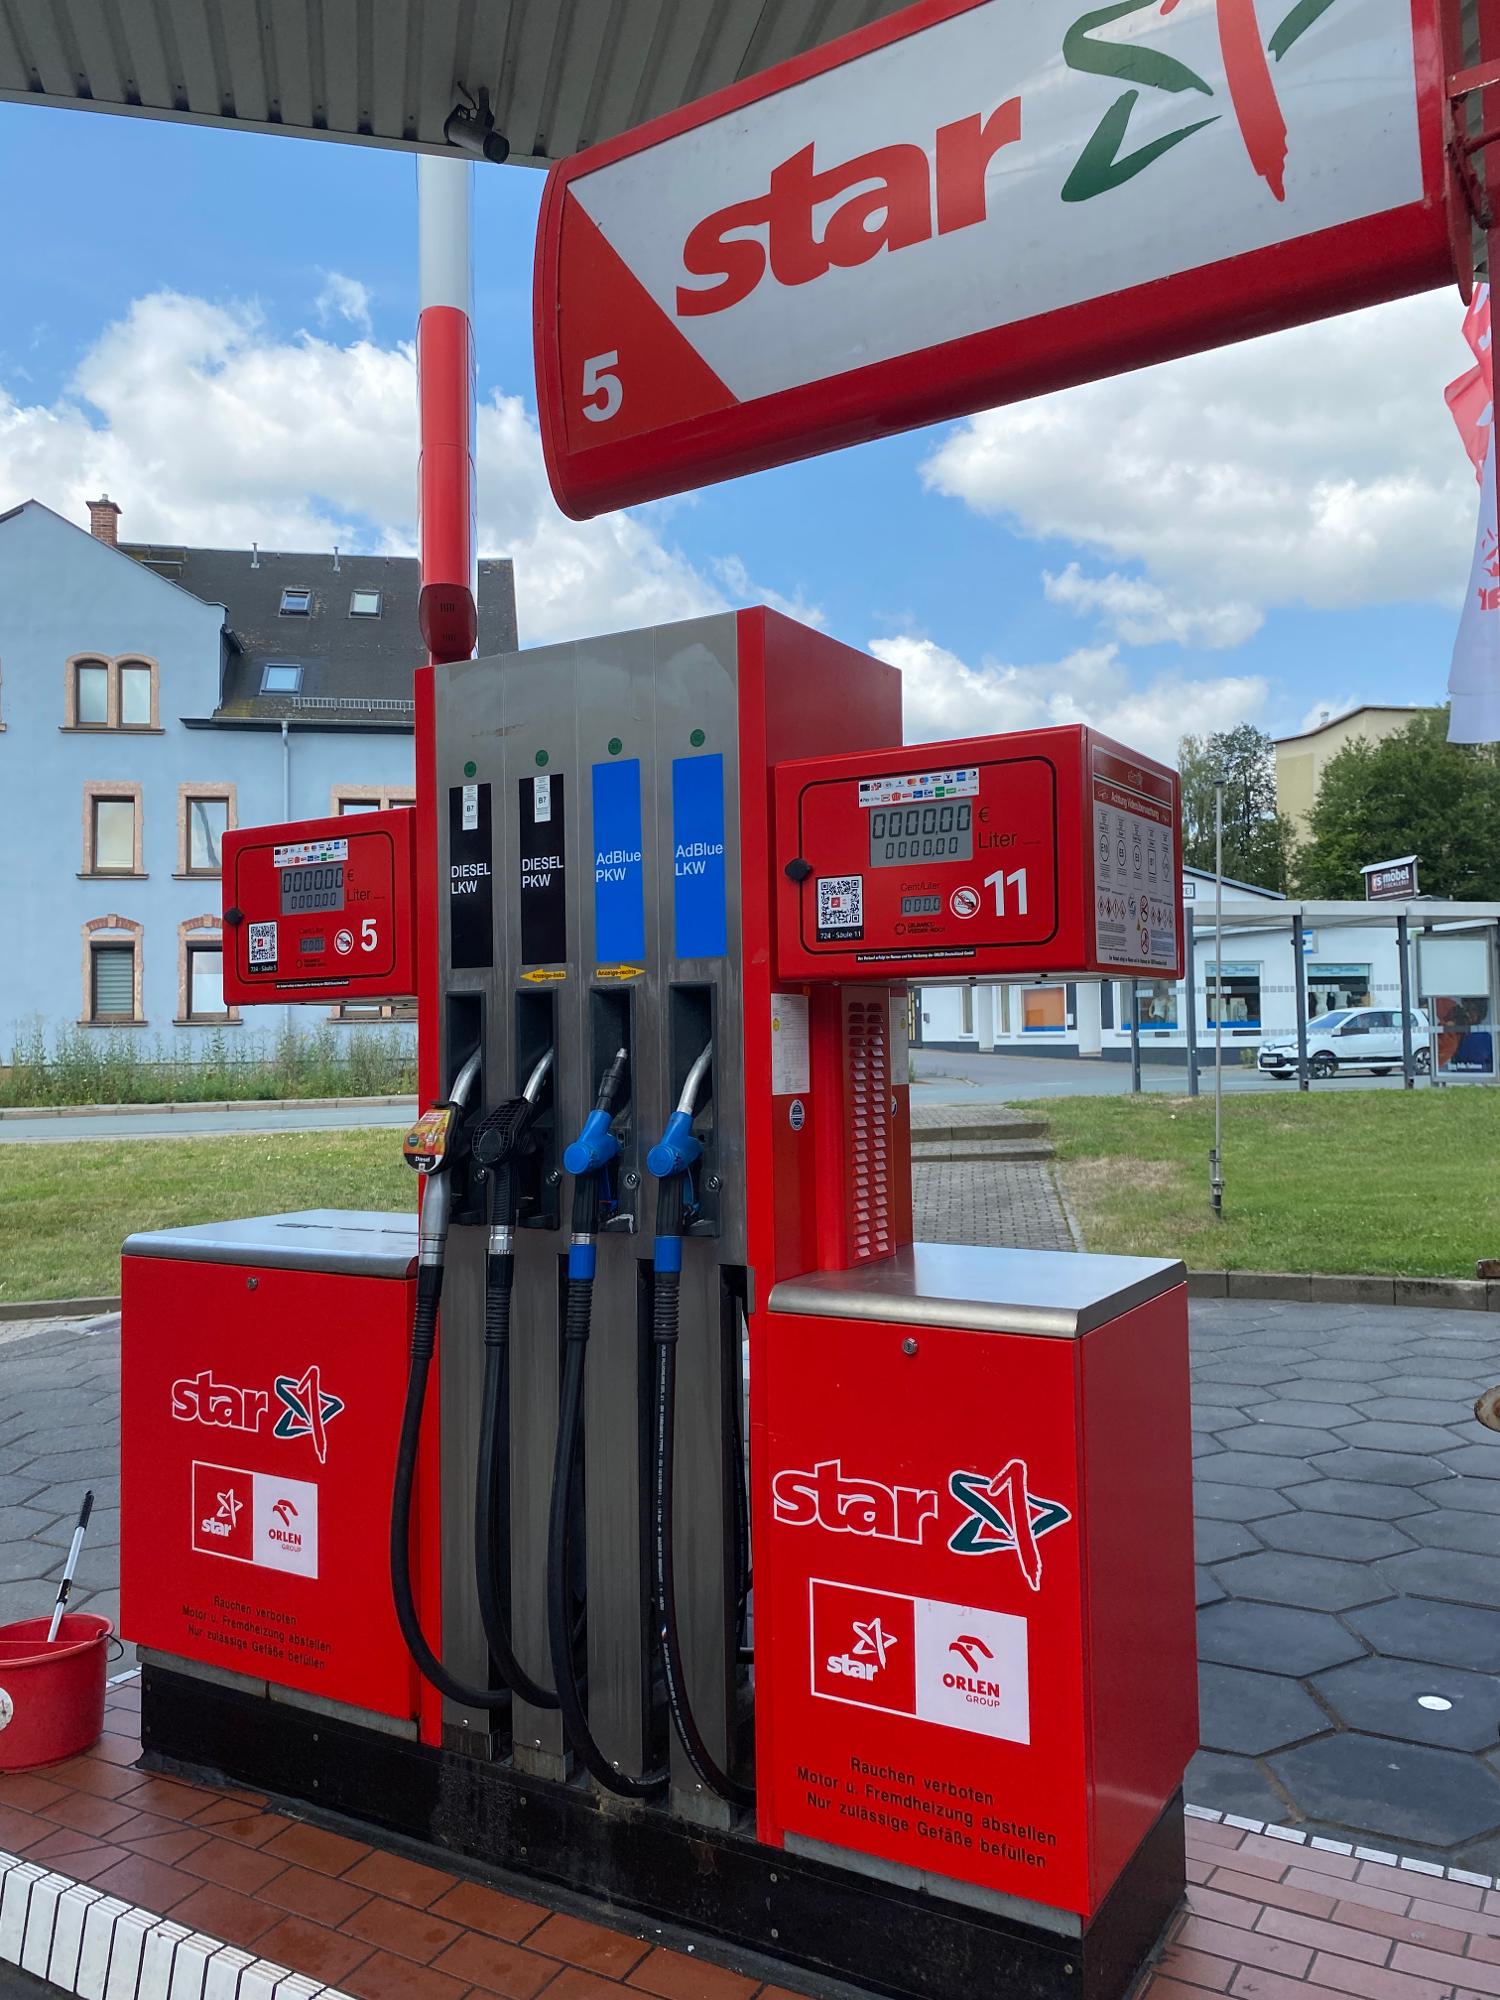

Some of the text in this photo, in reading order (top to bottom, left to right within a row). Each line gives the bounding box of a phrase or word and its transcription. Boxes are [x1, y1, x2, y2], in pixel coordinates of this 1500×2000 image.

[676, 96, 1022, 317] star
[582, 350, 624, 423] 5
[538, 796, 547, 804] B7
[466, 805, 474, 813] B7
[978, 807, 990, 822] €
[978, 831, 1018, 849] Liter
[596, 850, 641, 866] AdBlue
[675, 843, 724, 858] AdBlue
[451, 863, 491, 878] DIESEL
[522, 855, 564, 872] DIESEL
[675, 861, 706, 876] LKW
[347, 869, 354, 882] €
[522, 873, 551, 889] PKW
[596, 867, 626, 883] PKW
[1383, 866, 1410, 883] möbel
[347, 888, 371, 902] Liter
[451, 880, 478, 894] LKW
[984, 868, 1028, 917] 11
[361, 919, 377, 951] 5
[171, 1370, 268, 1432] star
[772, 1459, 938, 1545] star
[201, 1518, 232, 1537] star
[268, 1529, 302, 1546] ORLEN
[281, 1543, 302, 1553] GROUP
[214, 1595, 296, 1625] Rauchen verboten
[182, 1605, 206, 1620] Motor
[222, 1615, 285, 1643] Fremdheizung
[289, 1635, 332, 1653] abstellen
[188, 1624, 203, 1637] Nur
[207, 1630, 247, 1650] zulässige
[252, 1641, 284, 1659] Gefäße
[827, 1654, 879, 1682] star
[943, 1673, 1000, 1698] ORLEN
[965, 1694, 1000, 1708] GROUP
[851, 1757, 994, 1806] Rauchen verboten
[797, 1766, 1057, 1846] Motor u. Fremdheizung abstellen
[806, 1791, 1046, 1868] Nur zulässige Gefäße befüllen
